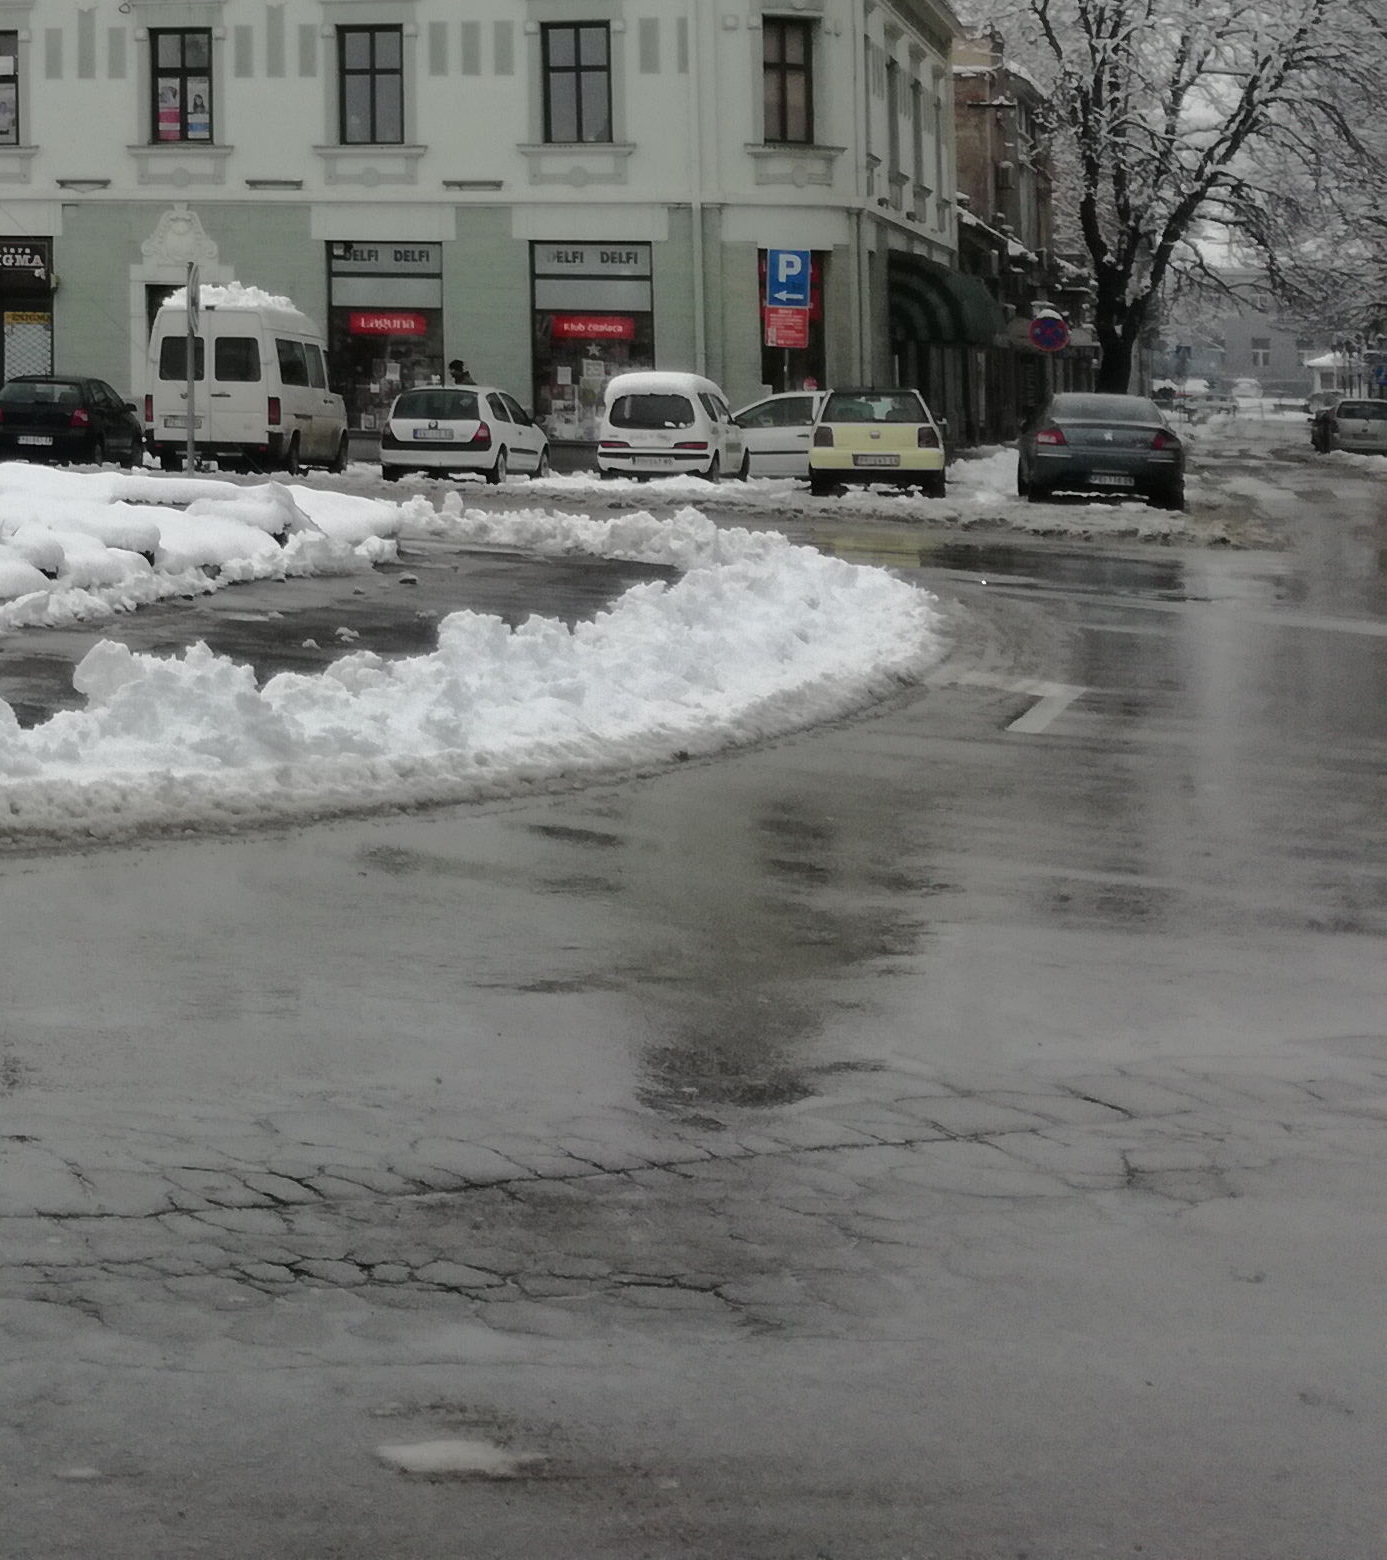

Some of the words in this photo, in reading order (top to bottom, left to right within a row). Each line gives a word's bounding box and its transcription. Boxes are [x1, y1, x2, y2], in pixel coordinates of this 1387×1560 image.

[393, 249, 430, 262] DELFI
[600, 251, 638, 264] DELFI
[778, 253, 802, 283] P
[360, 317, 415, 330] Laguna
